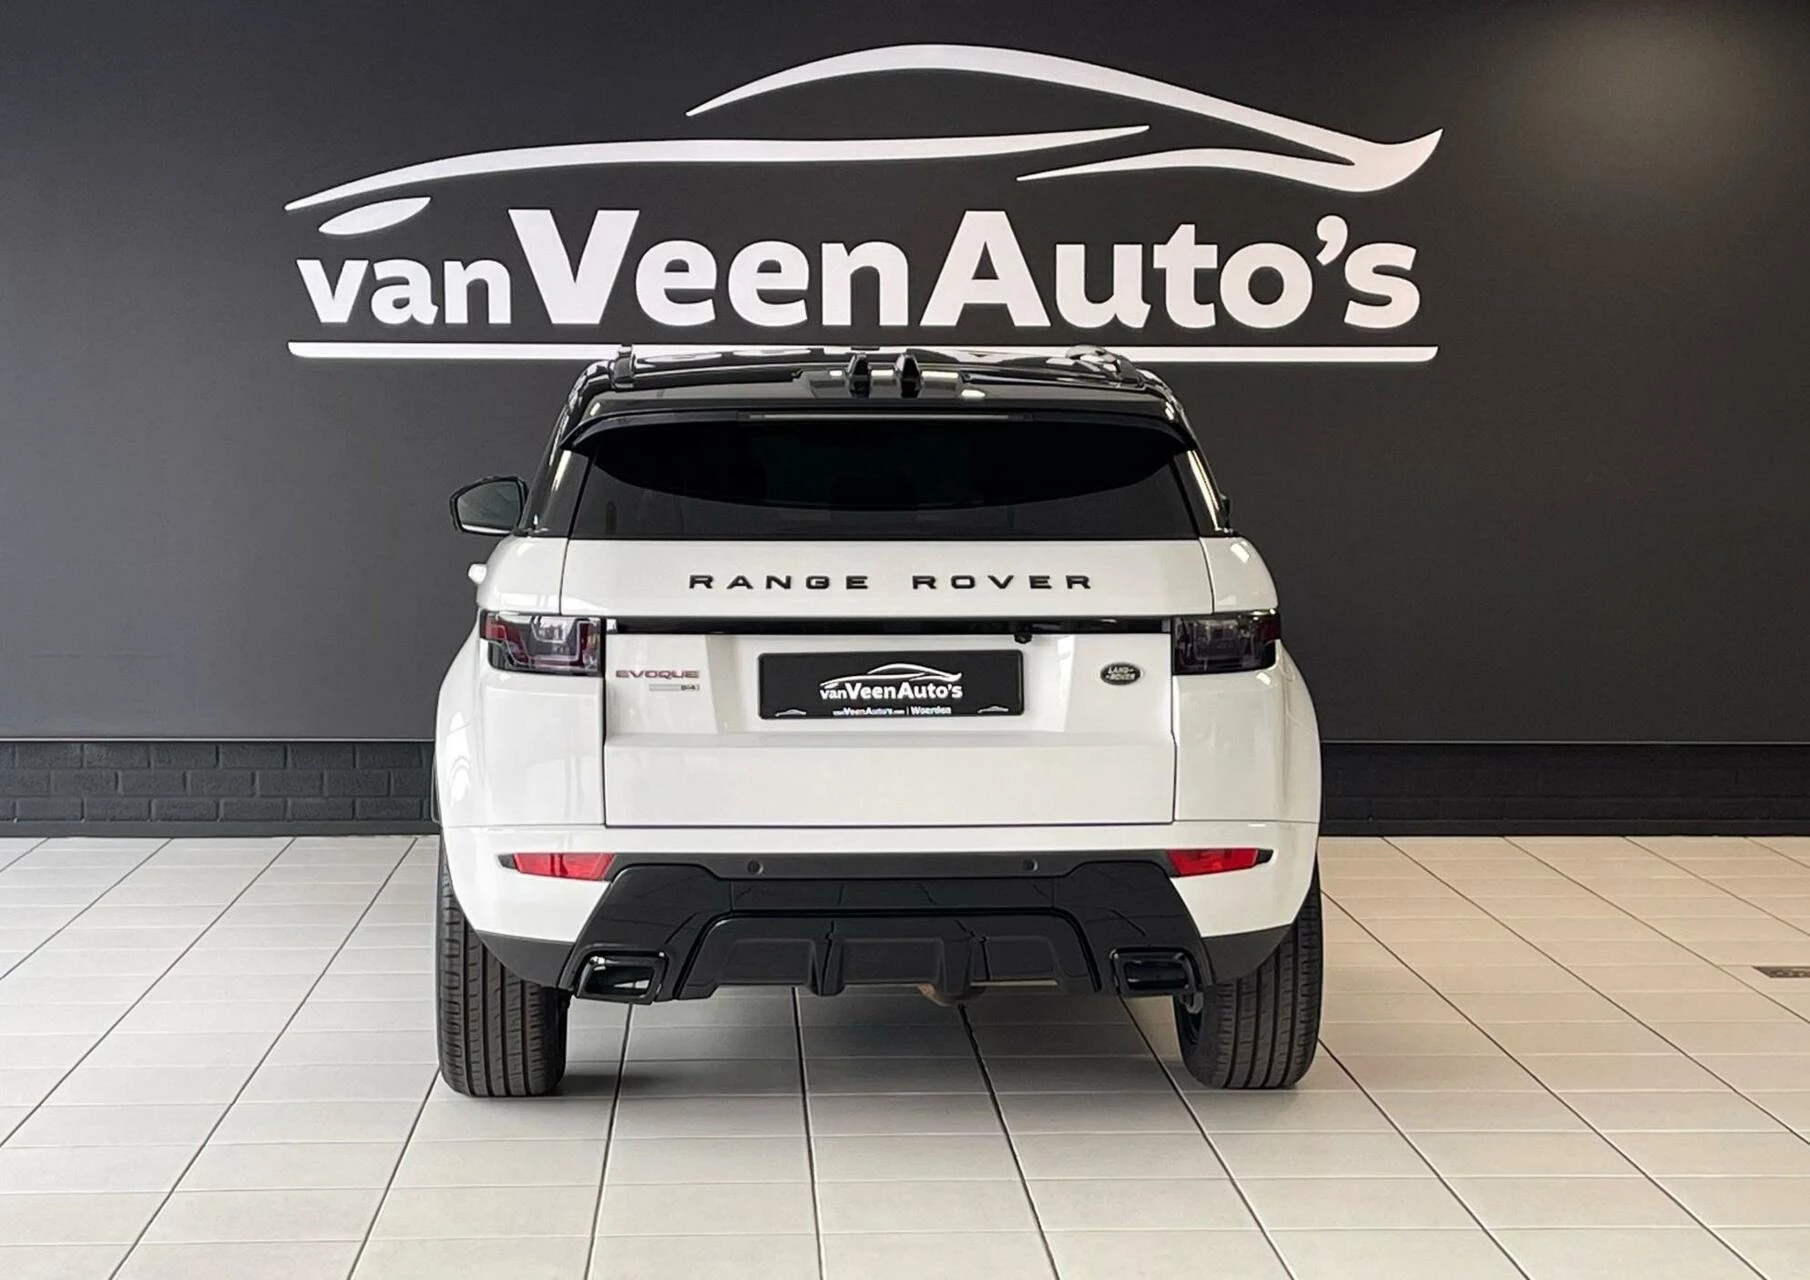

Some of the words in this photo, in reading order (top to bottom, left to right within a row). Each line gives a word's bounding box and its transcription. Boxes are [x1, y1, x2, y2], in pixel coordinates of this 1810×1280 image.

[689, 575, 869, 590] RANGE
[912, 575, 1091, 590] ROVER
[615, 669, 700, 680] EVOQUE
